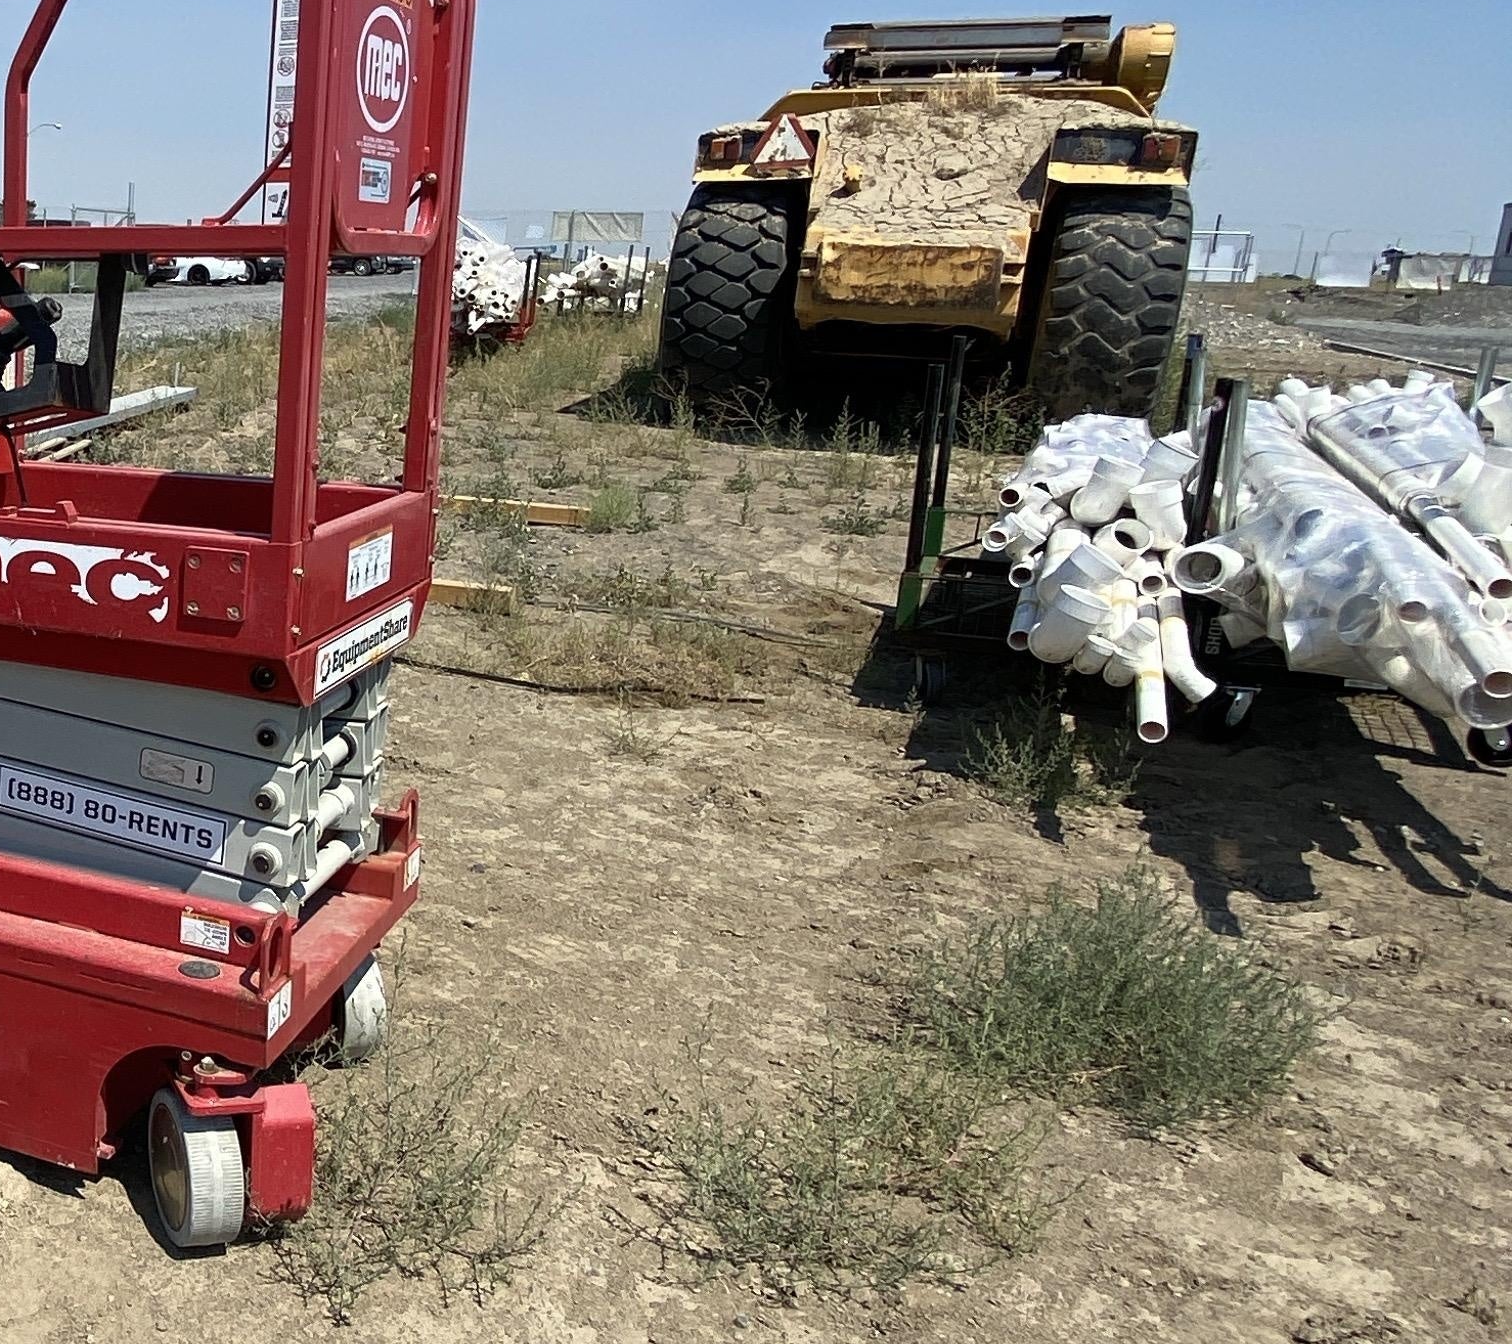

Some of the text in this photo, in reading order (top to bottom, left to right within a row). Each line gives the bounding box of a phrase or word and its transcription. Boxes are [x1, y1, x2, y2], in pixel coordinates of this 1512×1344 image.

[331, 615, 408, 673] EquipmentShare
[7, 777, 213, 850] (888) 80-RENTS
